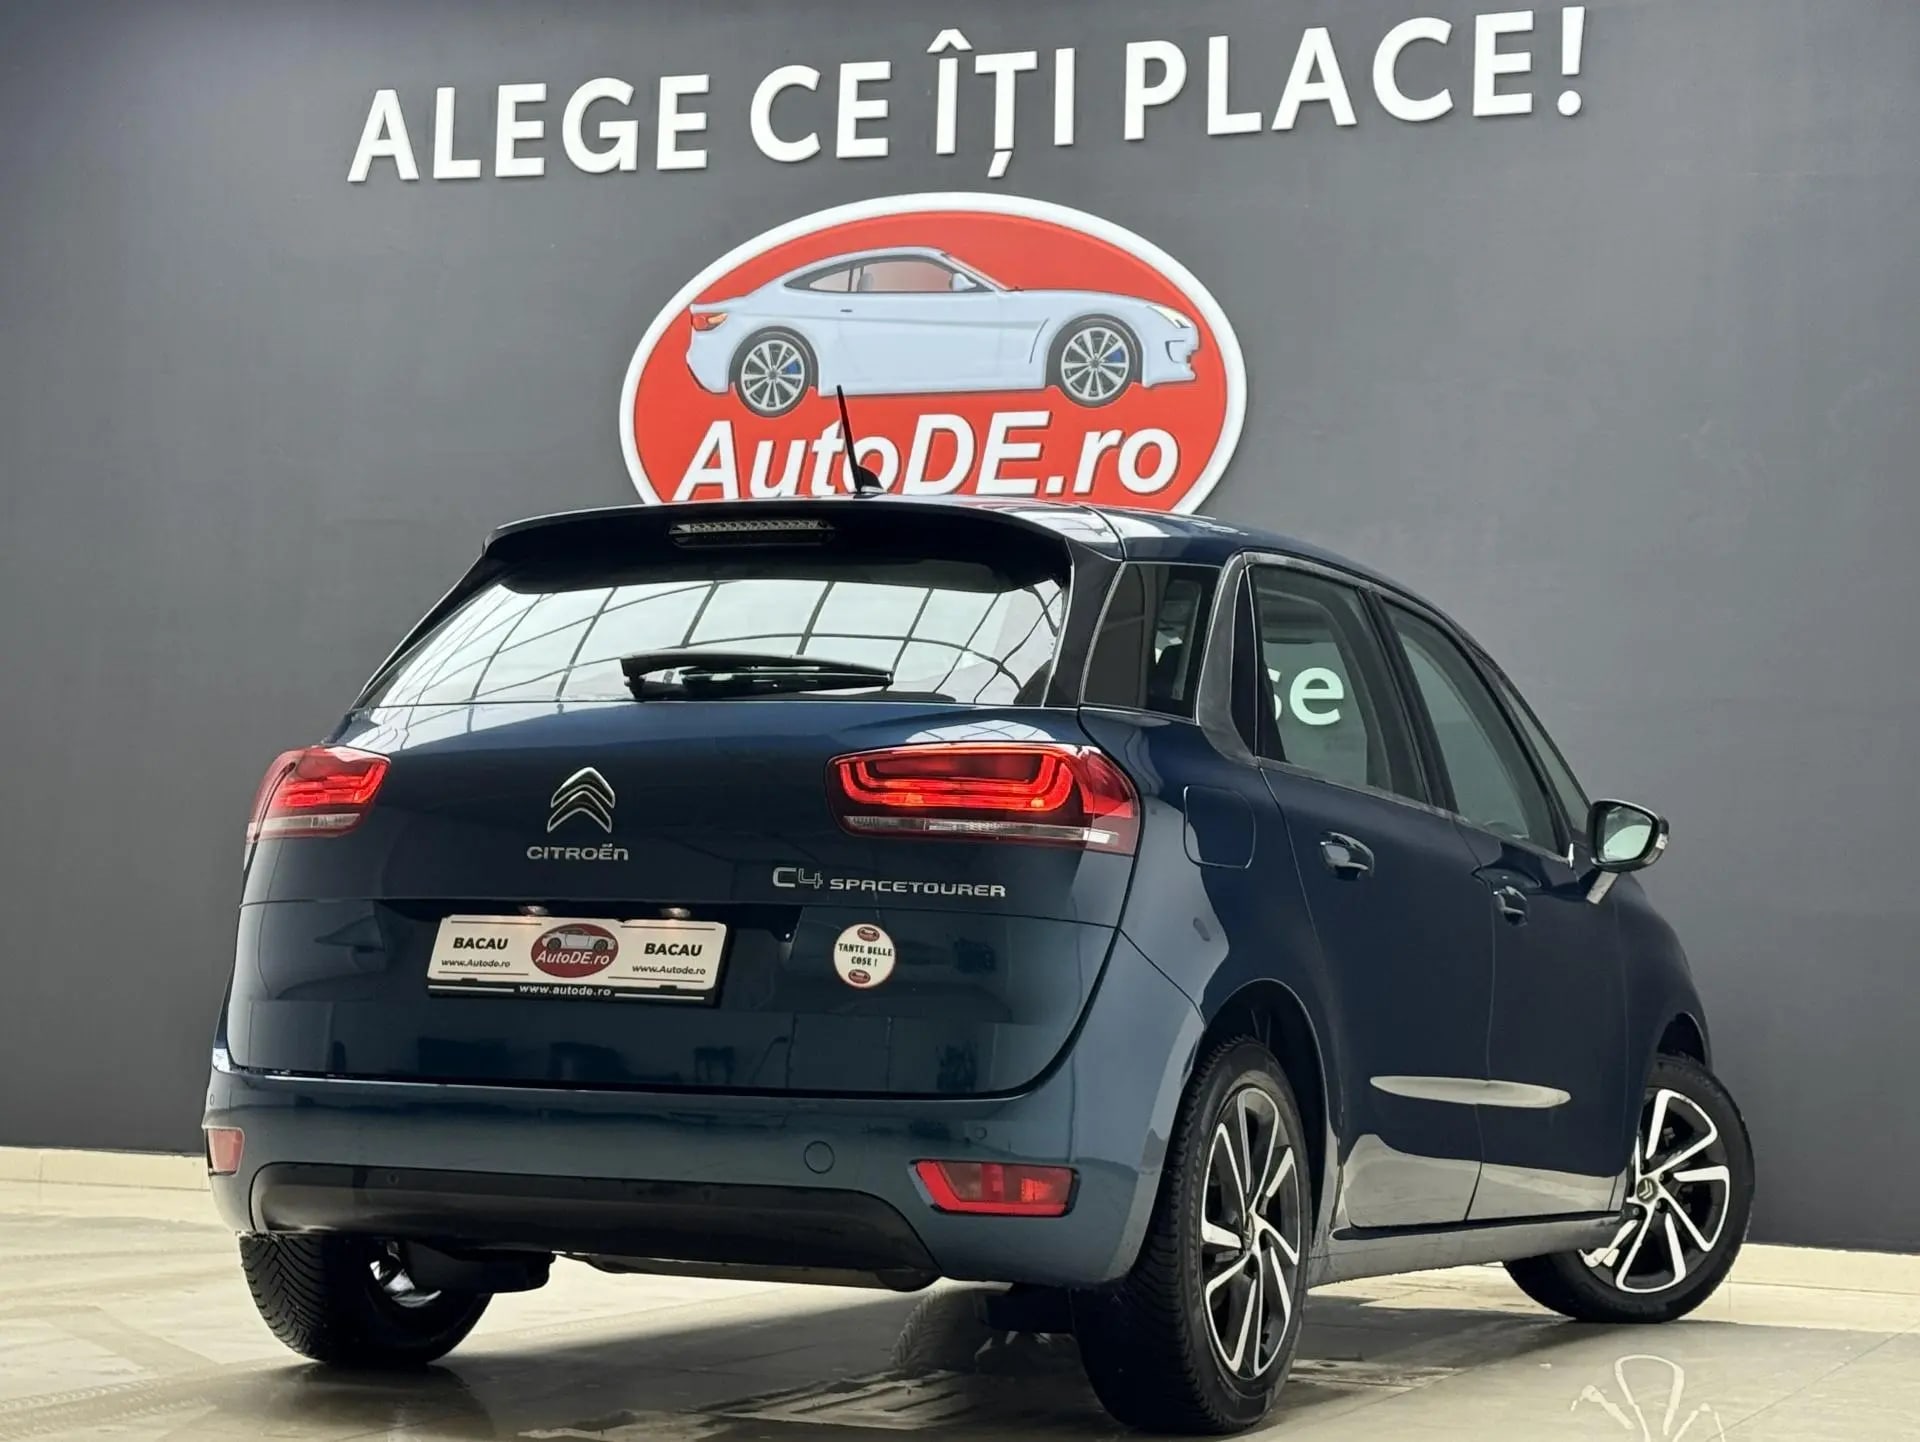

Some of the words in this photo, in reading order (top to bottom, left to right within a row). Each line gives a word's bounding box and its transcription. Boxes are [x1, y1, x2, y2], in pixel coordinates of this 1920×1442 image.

[347, 74, 709, 183] ALEGE
[750, 61, 891, 162] CE
[927, 29, 1075, 178] ÎȚI
[1124, 6, 1586, 141] PLACE!
[673, 410, 1179, 502] AutoDE.ro
[772, 867, 823, 888] C4
[829, 878, 1006, 897] SPACETOURER
[453, 937, 508, 950] BACAU
[644, 943, 703, 957] BACAU
[838, 943, 865, 953] TANTE
[867, 946, 893, 957] BELLE
[535, 949, 610, 966] AutoDE.ro
[519, 984, 612, 997] www.autode.ro
